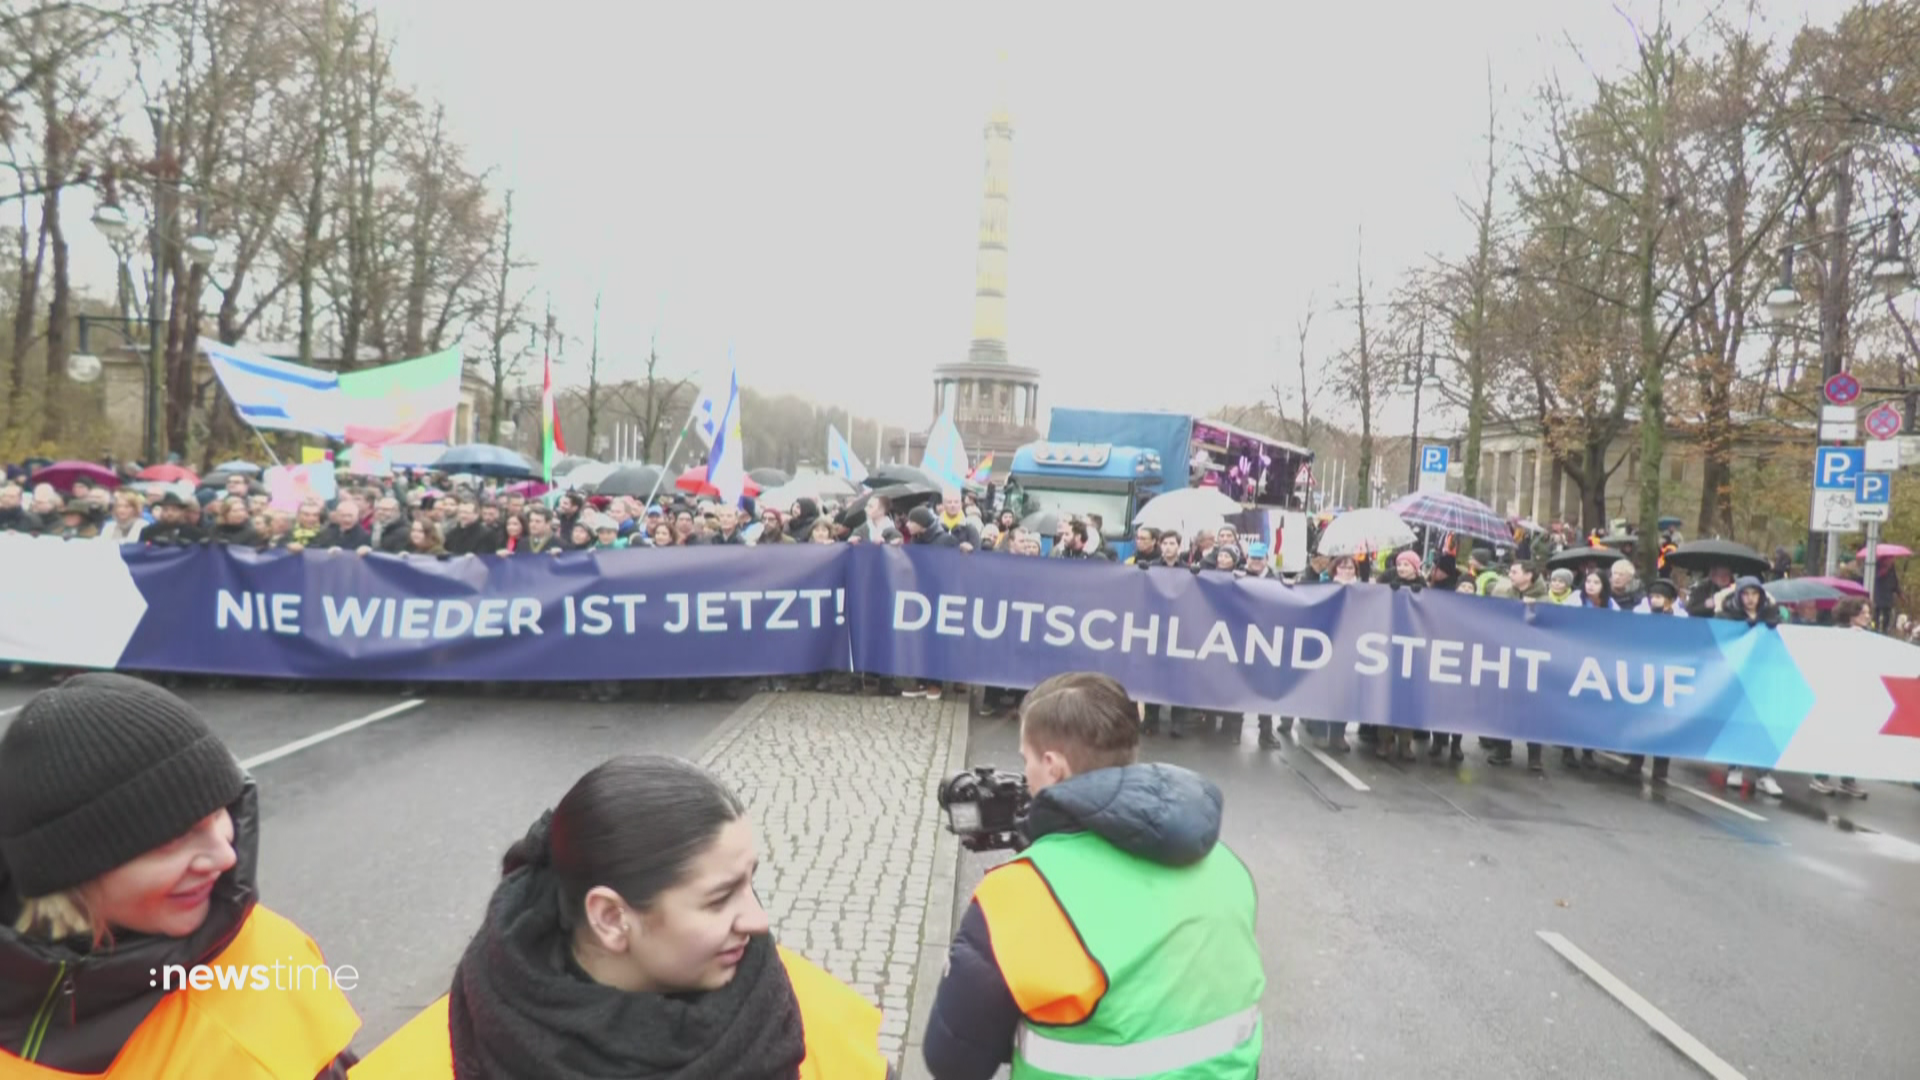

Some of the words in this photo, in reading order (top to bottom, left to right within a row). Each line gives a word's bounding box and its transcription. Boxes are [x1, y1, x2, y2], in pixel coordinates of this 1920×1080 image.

[1426, 449, 1441, 469] P
[1823, 452, 1851, 484] P
[1863, 477, 1882, 500] P
[216, 589, 301, 633] NIE
[322, 596, 544, 638] WIEDER
[564, 594, 646, 635] IST
[663, 588, 845, 632] JETZT!
[893, 590, 1333, 669] DEUTSCHLAND
[1354, 632, 1551, 692] STEHT
[1568, 656, 1696, 708] AUF
